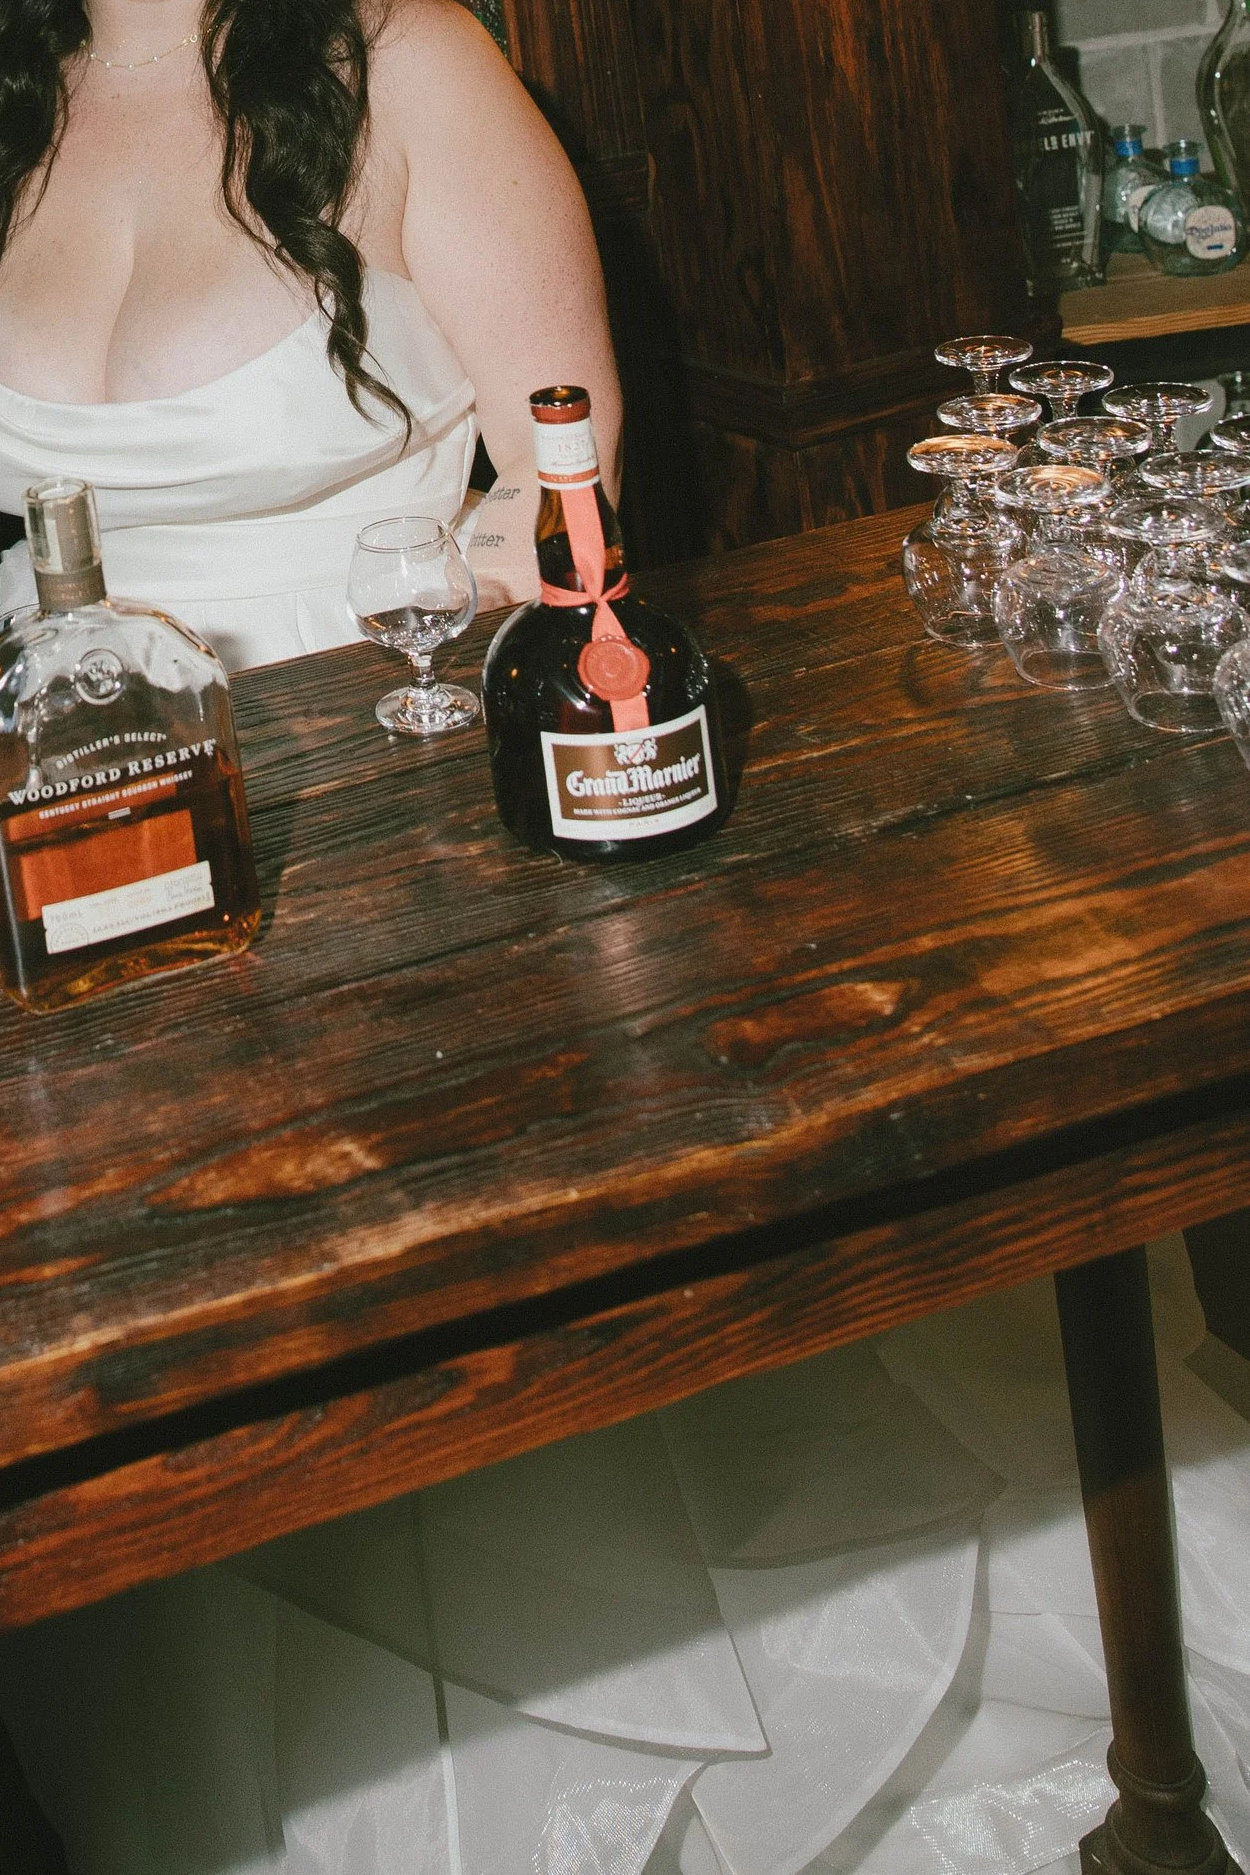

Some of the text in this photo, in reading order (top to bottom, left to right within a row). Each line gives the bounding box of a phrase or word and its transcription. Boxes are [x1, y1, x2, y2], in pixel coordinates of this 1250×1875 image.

[7, 738, 216, 806] WOODFORD RESERVE
[55, 732, 163, 770] DISTILLER'S SELECT
[566, 752, 701, 798] Grand Marnier
[38, 770, 193, 820] KENTUCKY STRAIGHT BOURBON WHISKEY
